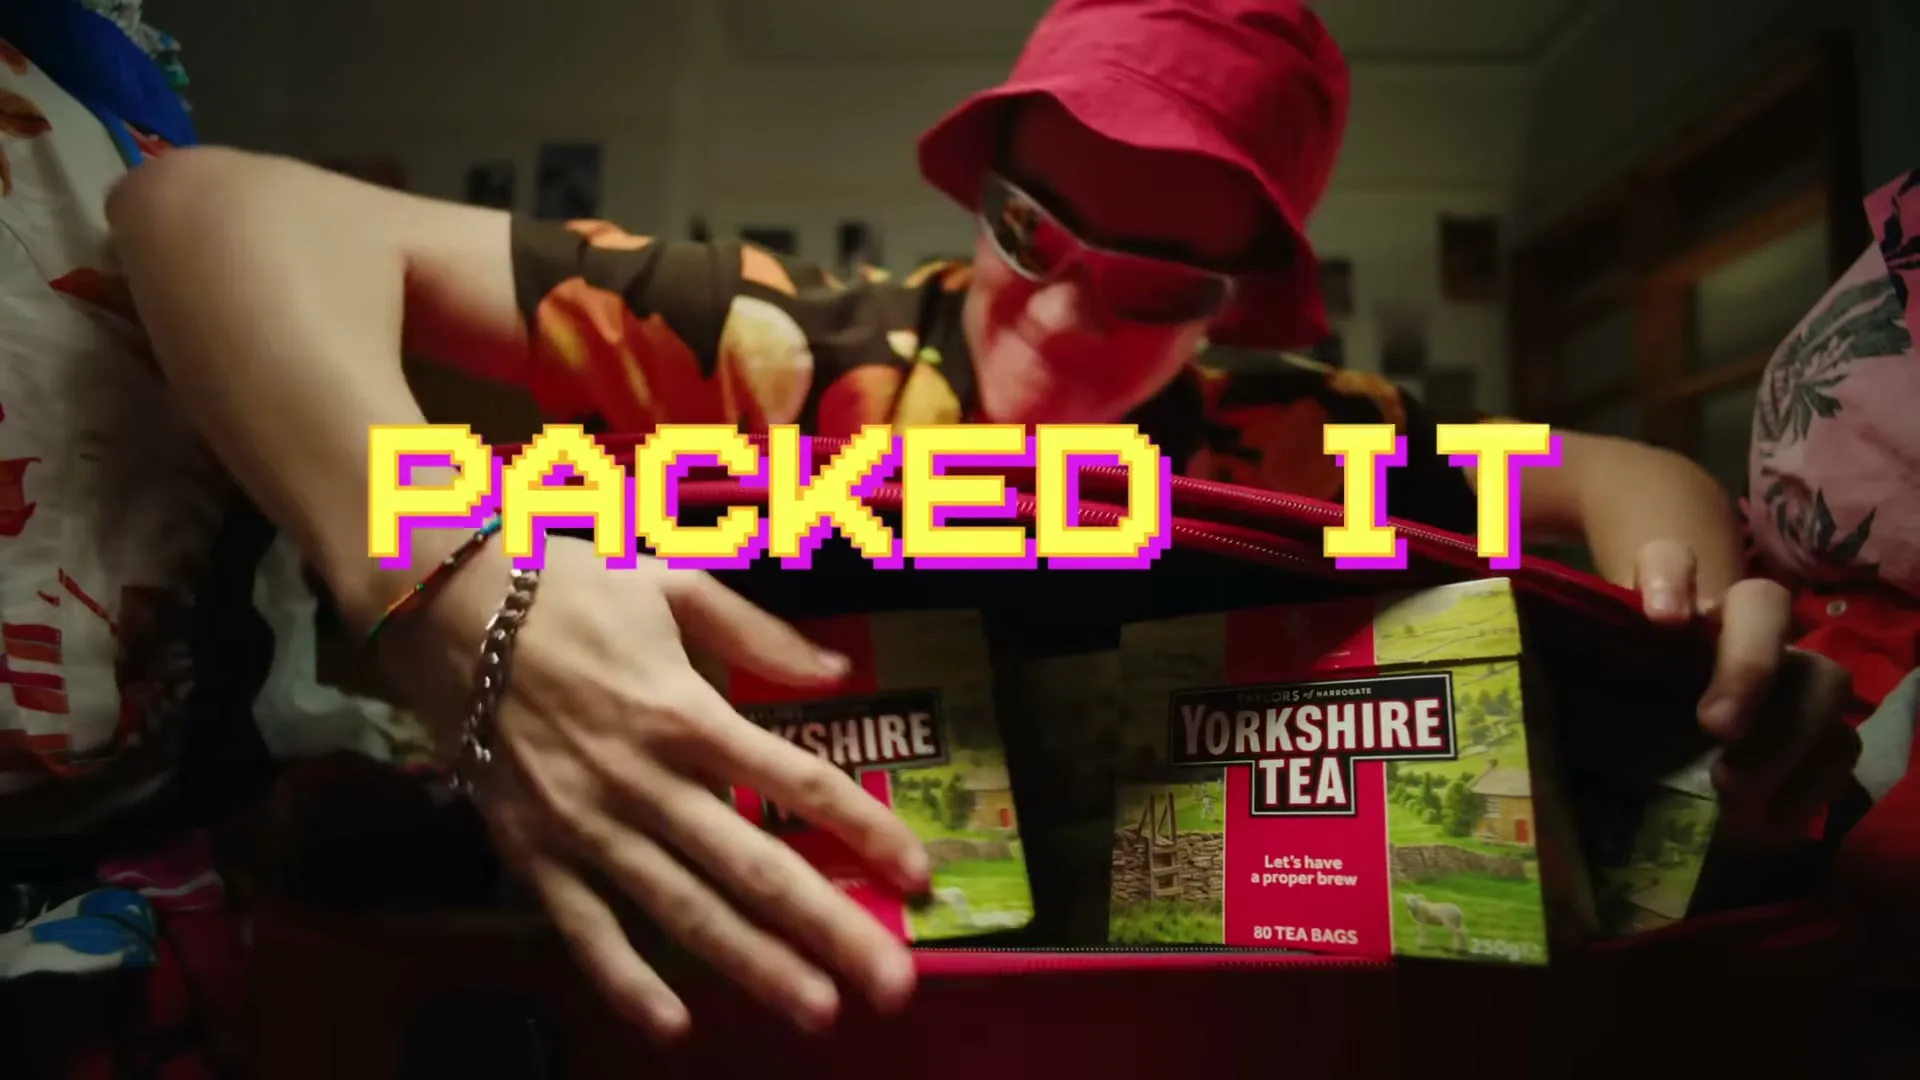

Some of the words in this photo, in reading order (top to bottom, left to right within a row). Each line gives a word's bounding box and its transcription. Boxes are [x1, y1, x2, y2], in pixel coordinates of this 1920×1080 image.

[1302, 688, 1315, 700] of
[1316, 687, 1372, 698] HARROGATE
[1180, 698, 1443, 757] YORKSHIRE
[1259, 757, 1347, 807] TEA
[1264, 854, 1302, 869] Let's
[1304, 854, 1343, 871] have
[1250, 872, 1260, 884] a
[1262, 872, 1315, 888] proper
[1316, 871, 1359, 887] brew
[1253, 925, 1273, 940] 80
[1274, 926, 1308, 942] TEA
[1311, 927, 1359, 945] BAGS
